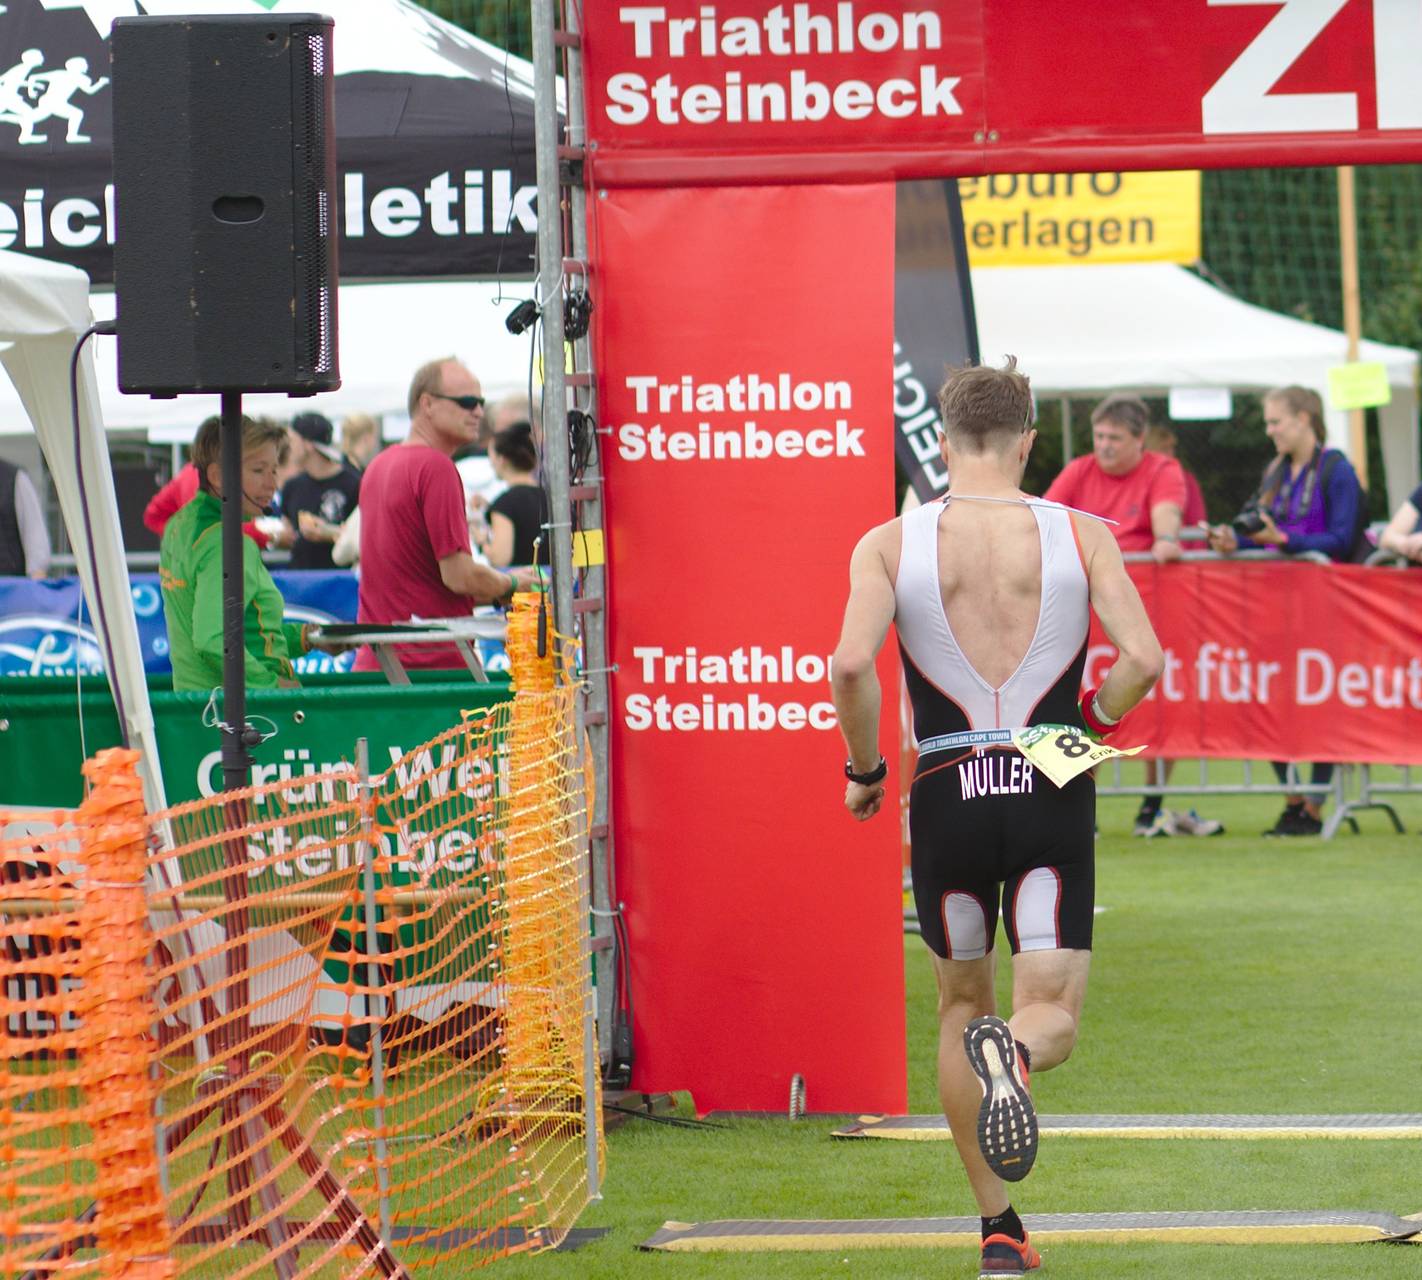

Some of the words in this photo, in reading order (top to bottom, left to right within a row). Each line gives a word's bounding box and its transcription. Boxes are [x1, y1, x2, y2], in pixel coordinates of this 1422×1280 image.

[619, 3, 942, 58] Triathlon
[605, 65, 963, 125] Steinbeck
[626, 373, 852, 413] Triathlon
[618, 420, 866, 461] Steinbeck
[633, 646, 836, 684] Triathlo
[1196, 643, 1281, 703] für
[624, 693, 840, 731] Steinbec
[958, 749, 1033, 800] MÜLLER
